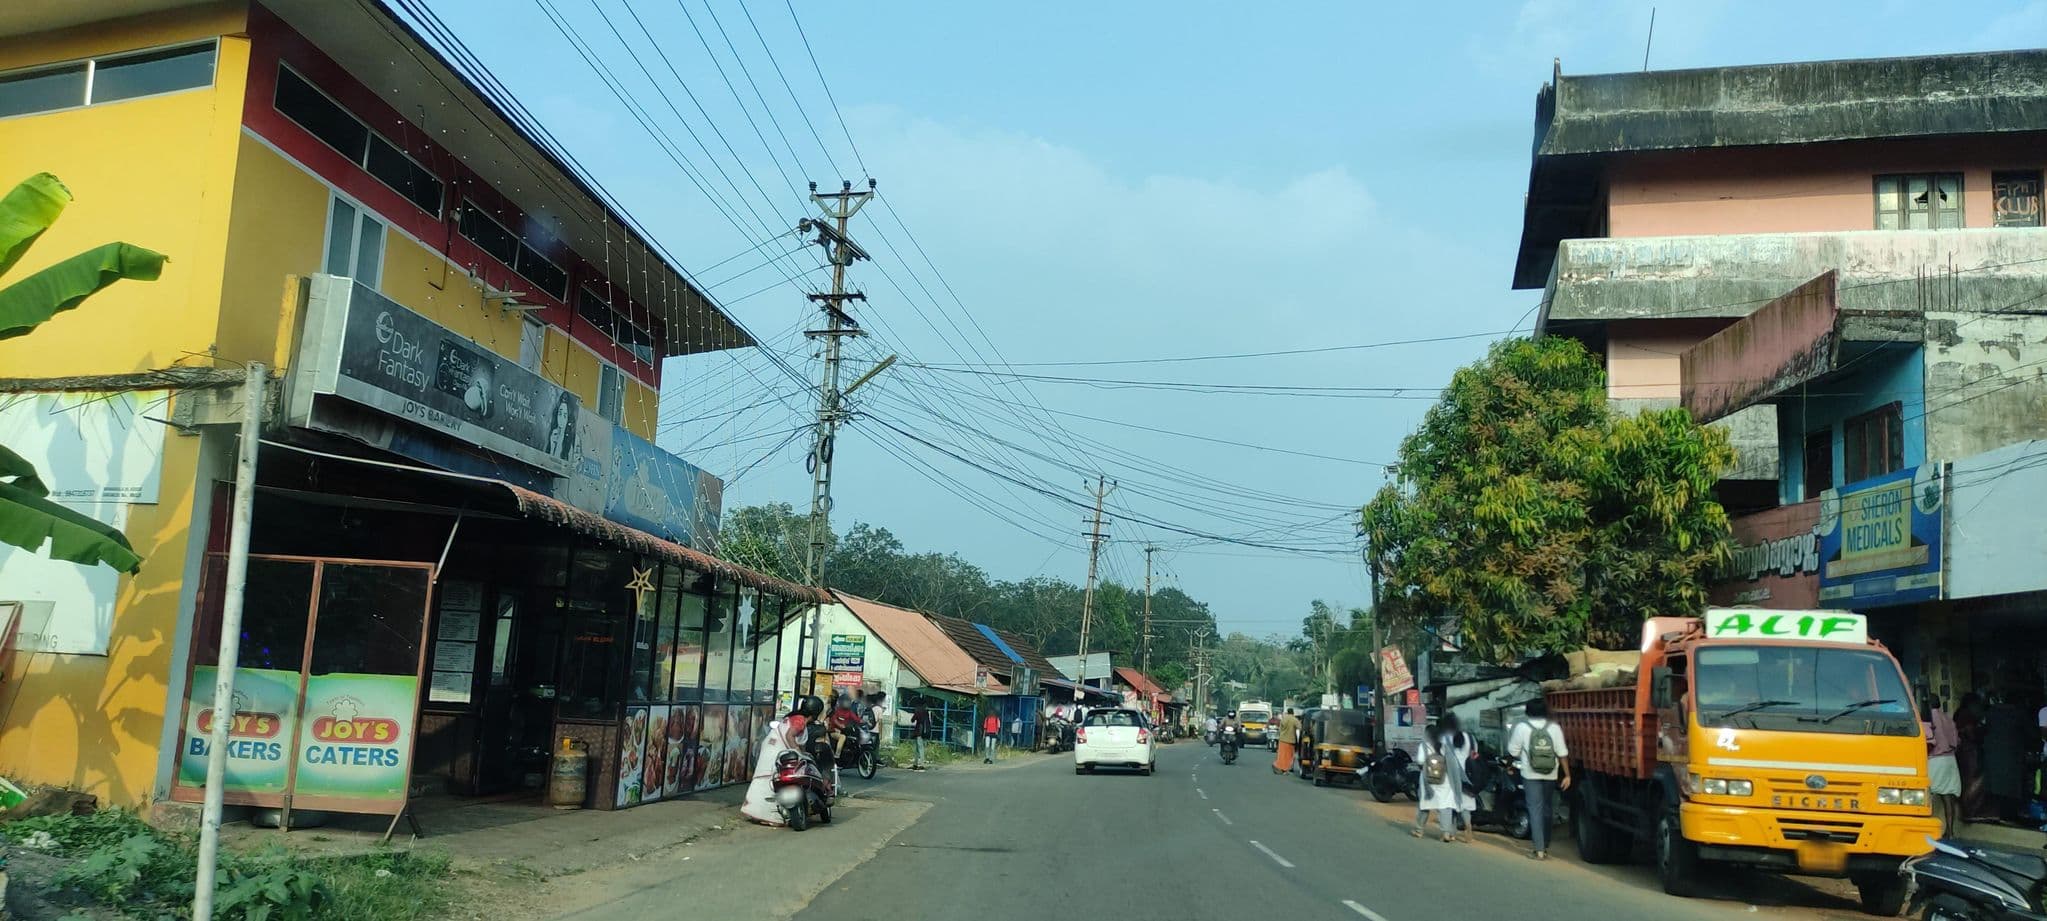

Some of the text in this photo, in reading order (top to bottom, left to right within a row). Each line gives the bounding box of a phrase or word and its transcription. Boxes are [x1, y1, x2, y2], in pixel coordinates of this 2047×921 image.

[1996, 195, 2039, 216] CLUB
[392, 332, 424, 365] Dark
[378, 349, 430, 393] Fantasy
[402, 400, 426, 418] JOYS
[1861, 489, 1903, 521] SHERON
[1846, 517, 1903, 553] MEDICALS
[1714, 613, 1859, 638] ALIF
[204, 714, 272, 734] JY'S
[320, 721, 389, 740] JOY'S
[190, 738, 282, 762] BKERS
[305, 745, 400, 768] CATERS
[1773, 795, 1859, 810] EICHER
